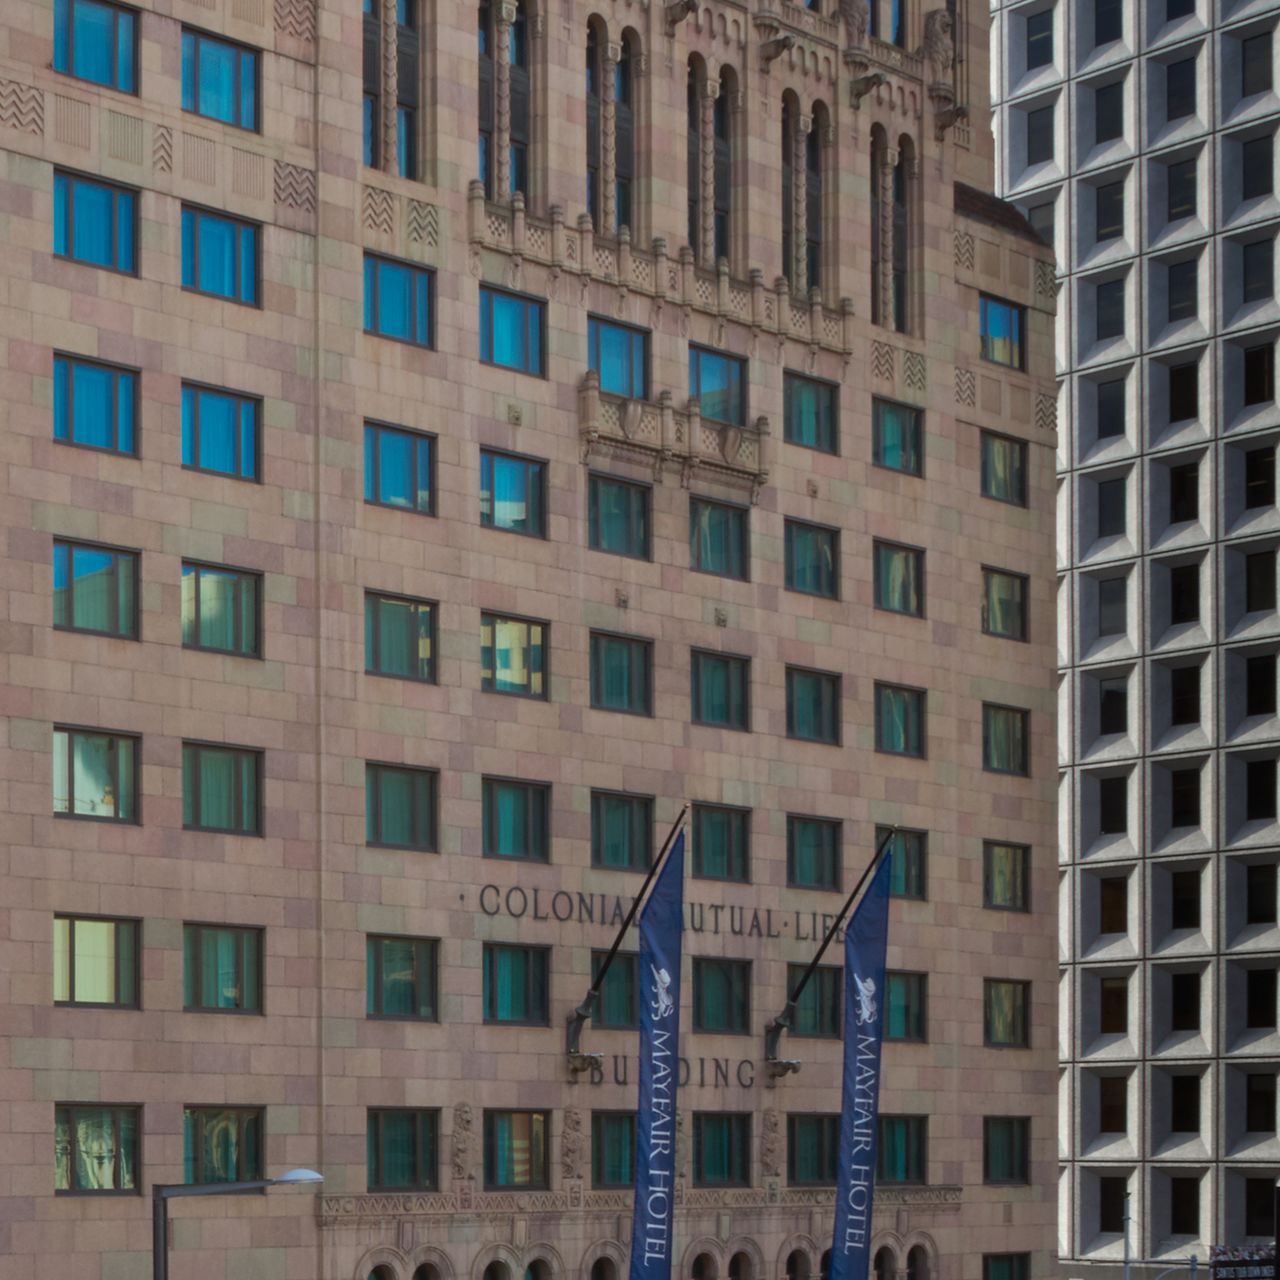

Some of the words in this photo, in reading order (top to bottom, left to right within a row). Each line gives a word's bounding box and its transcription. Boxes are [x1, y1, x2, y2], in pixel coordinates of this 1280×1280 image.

[479, 884, 640, 928] COLONIAL
[681, 902, 780, 938] UTUAL
[590, 1054, 755, 1089] BUDING
[649, 1028, 672, 1161] MAYFAIR
[851, 1033, 877, 1157] MAYFAIR
[644, 1169, 670, 1267] HOTEL
[844, 1163, 871, 1256] HOTEL
